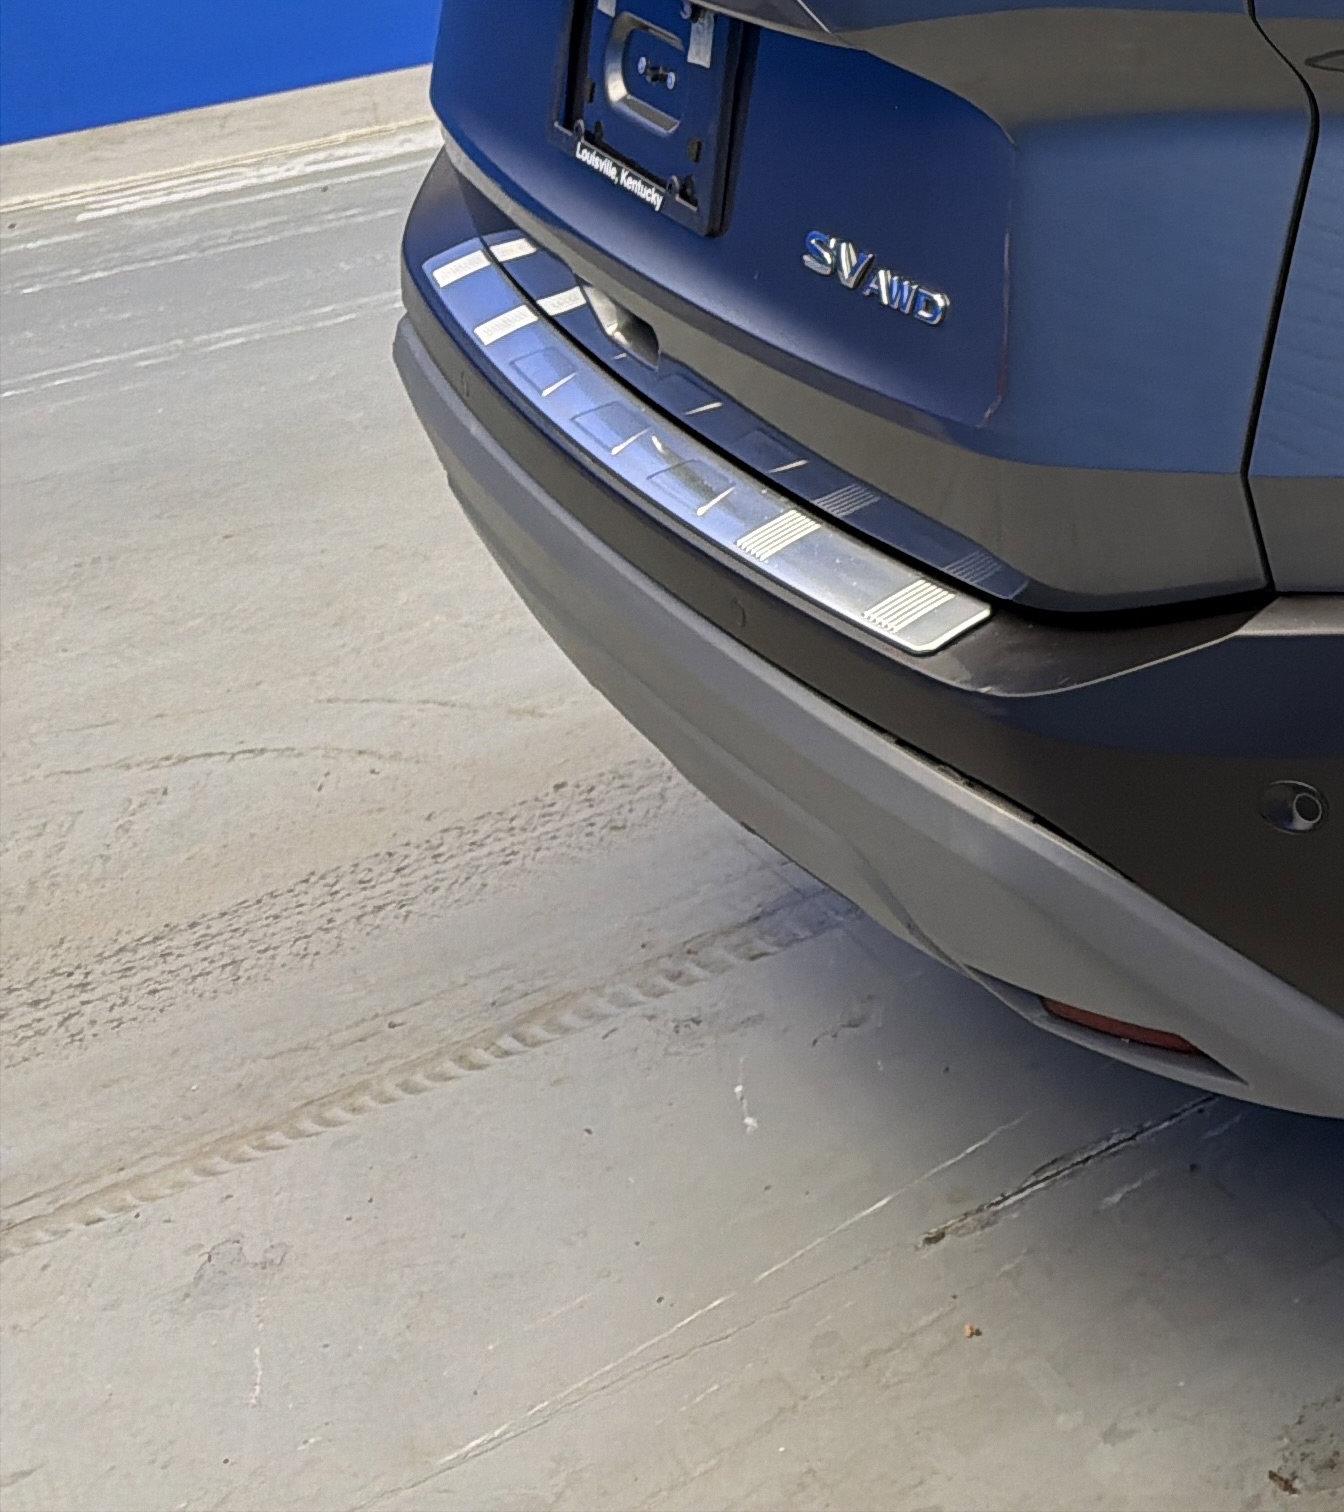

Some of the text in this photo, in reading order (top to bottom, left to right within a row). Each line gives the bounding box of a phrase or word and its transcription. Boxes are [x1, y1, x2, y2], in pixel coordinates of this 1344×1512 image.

[575, 141, 663, 212] Louisville, Kentucky
[802, 230, 951, 326] SV AWD
